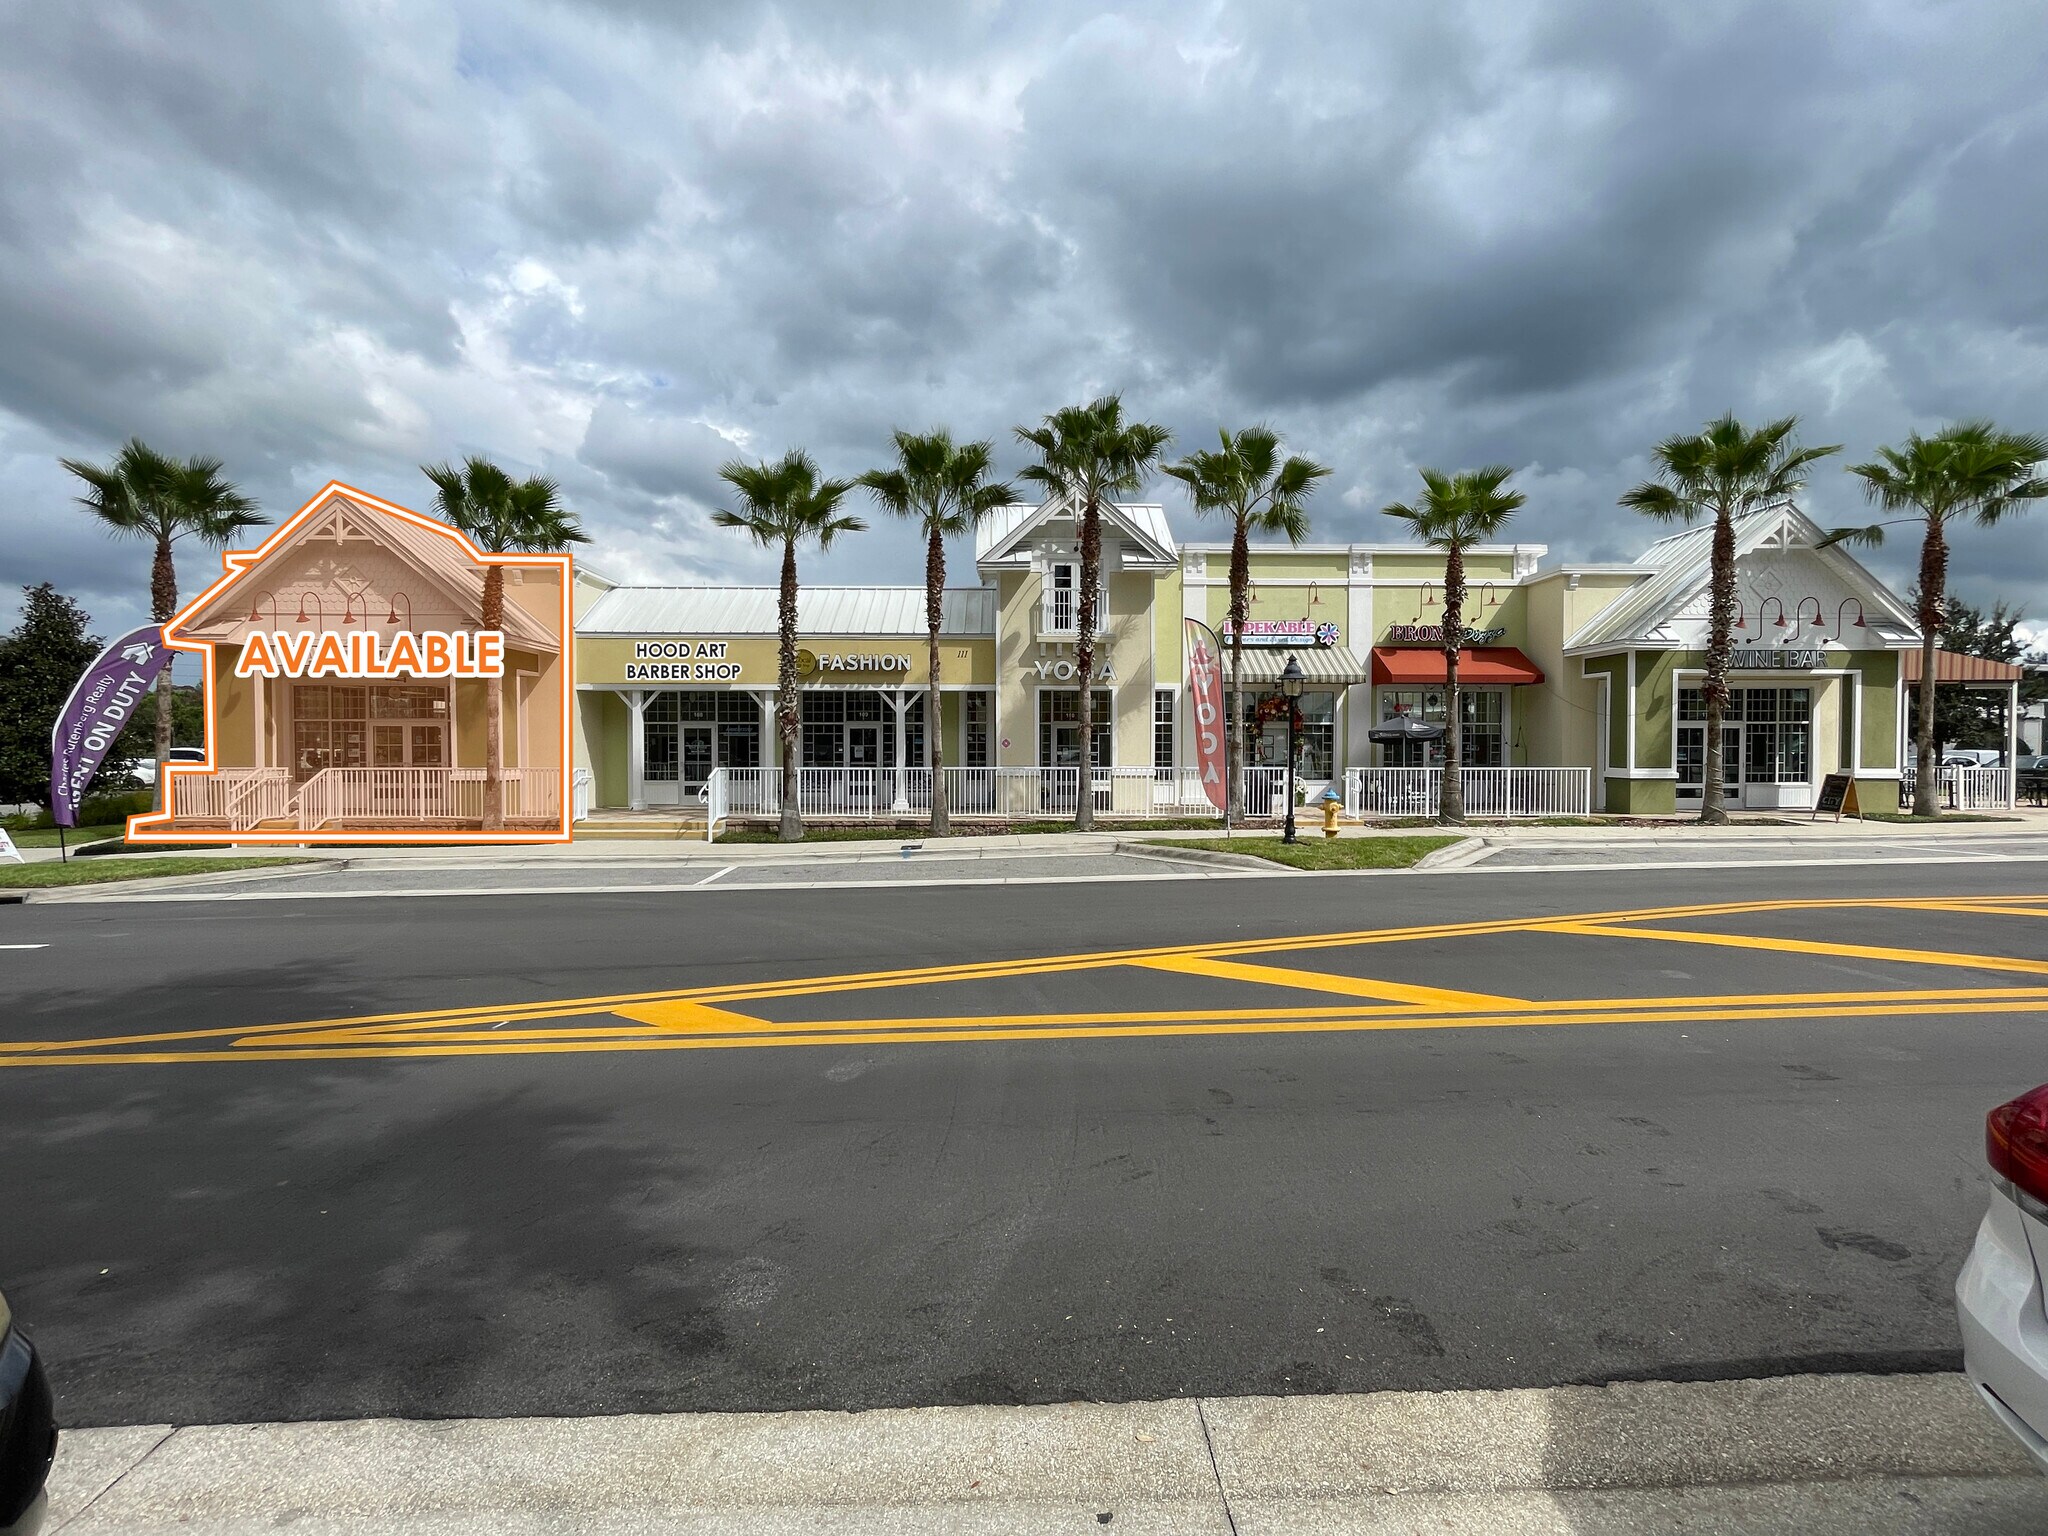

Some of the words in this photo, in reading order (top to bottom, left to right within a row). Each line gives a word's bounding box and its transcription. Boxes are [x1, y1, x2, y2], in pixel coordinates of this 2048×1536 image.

[1224, 622, 1315, 634] IPEKABLE
[1391, 625, 1444, 641] BRON
[819, 654, 912, 671] FASHION
[1729, 650, 1781, 668] WINE
[1789, 650, 1829, 668] BAR
[85, 673, 116, 706] Realty
[83, 721, 117, 751] ON
[102, 670, 147, 721] DUTY
